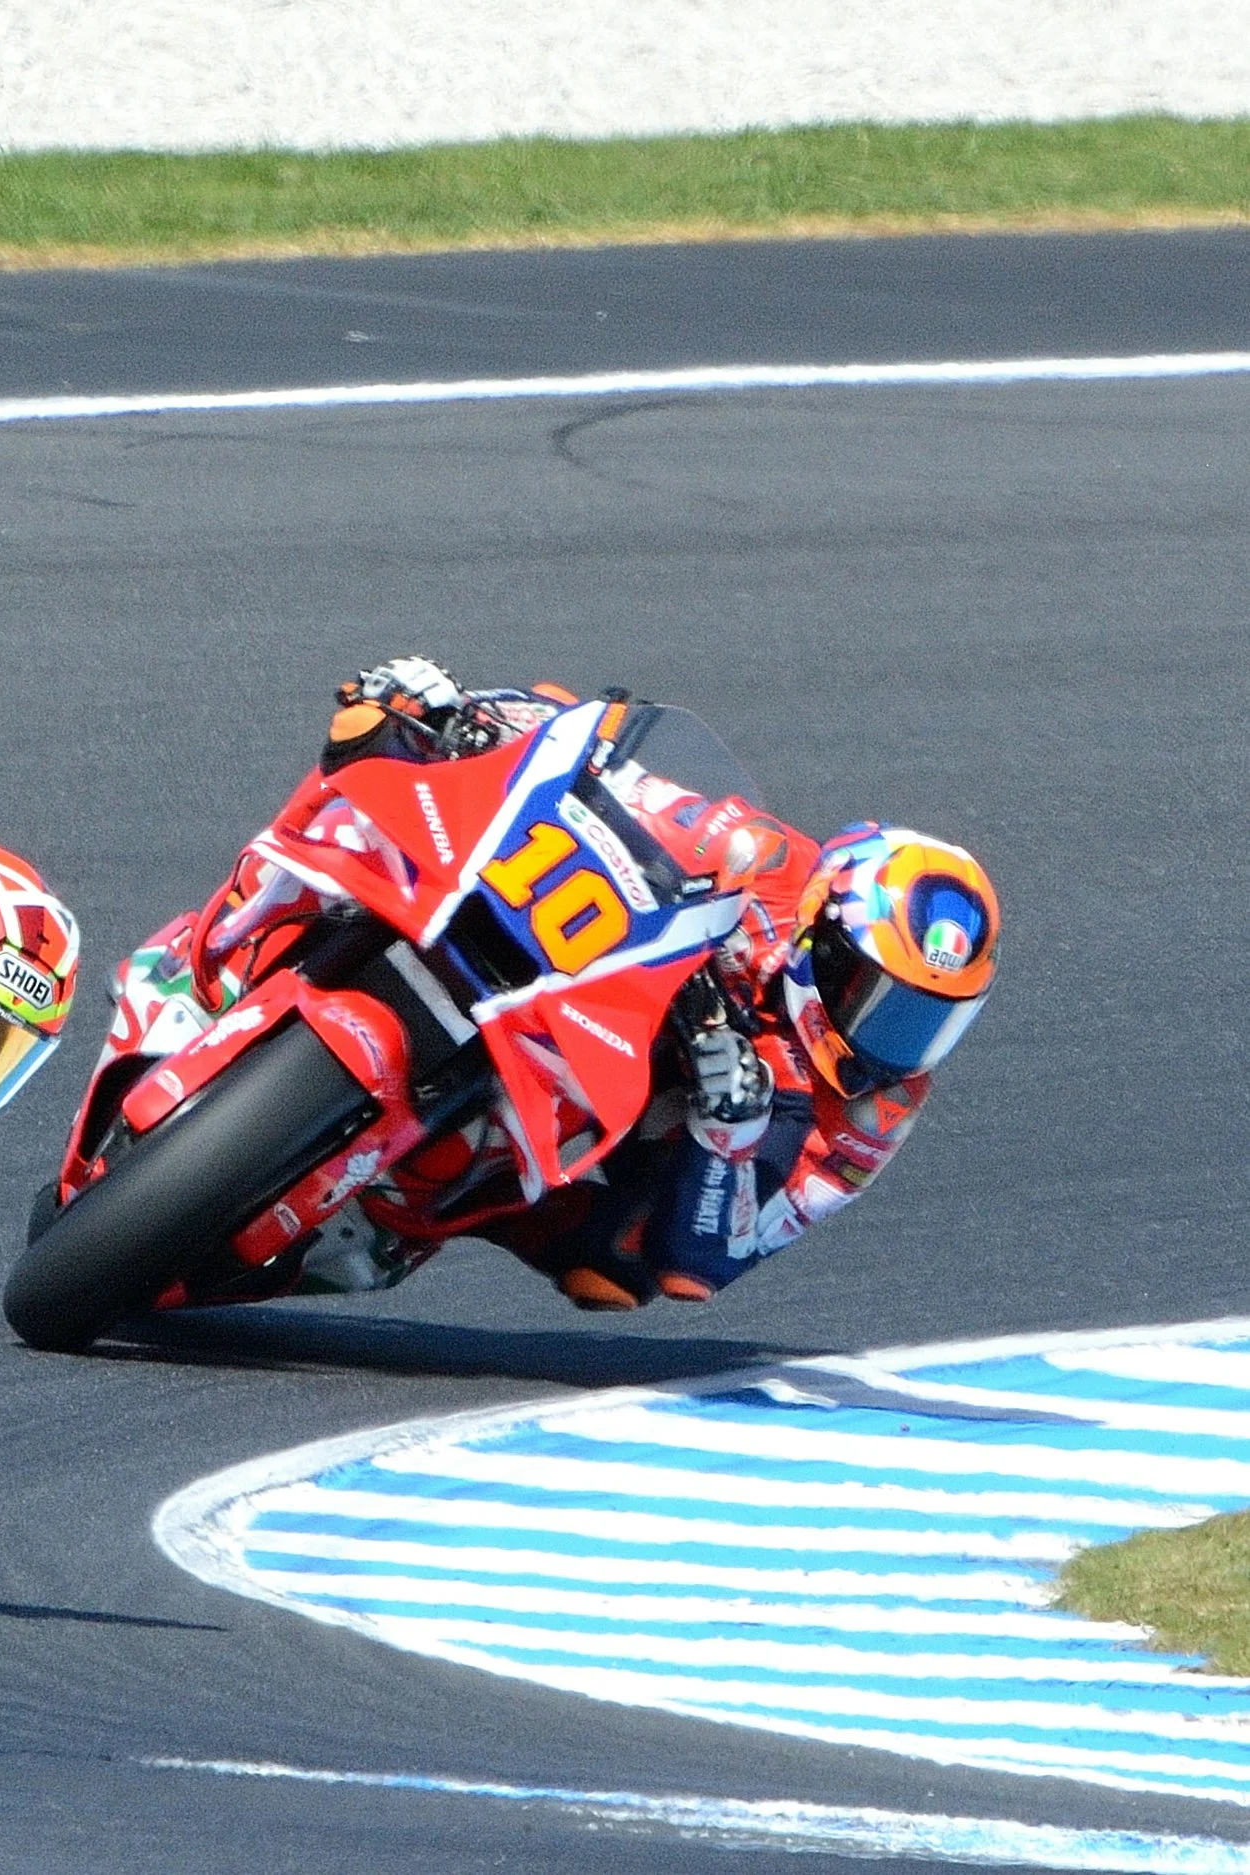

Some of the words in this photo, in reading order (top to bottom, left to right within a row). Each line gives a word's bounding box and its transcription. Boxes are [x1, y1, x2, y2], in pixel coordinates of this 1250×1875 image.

[414, 783, 455, 865] HONDA
[586, 823, 651, 908] Castrol
[476, 820, 631, 976] 10
[559, 1001, 636, 1057] HONDA
